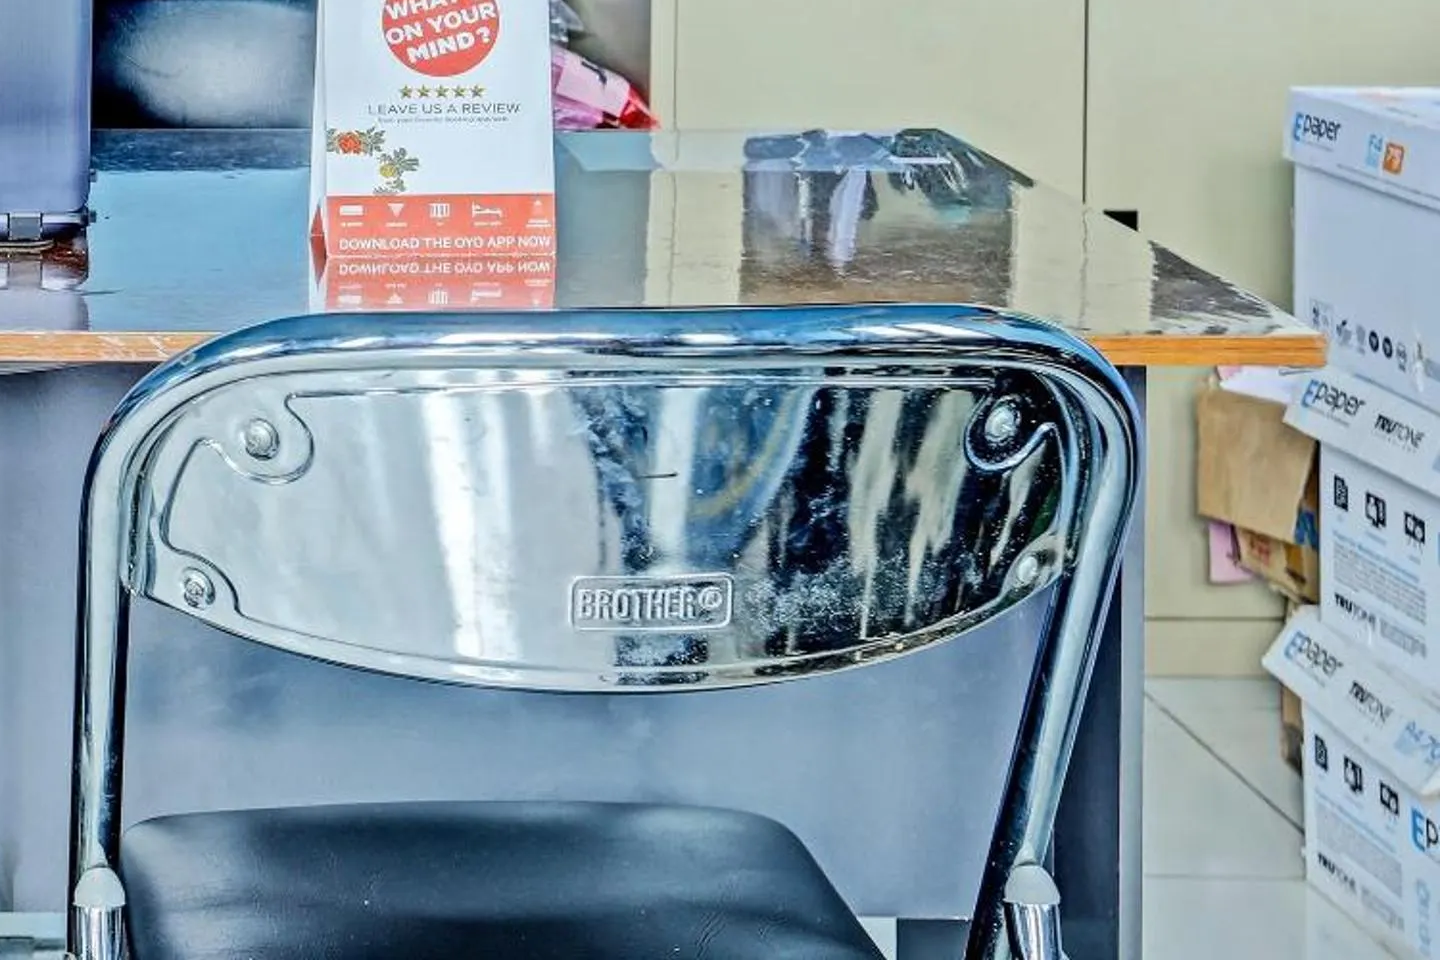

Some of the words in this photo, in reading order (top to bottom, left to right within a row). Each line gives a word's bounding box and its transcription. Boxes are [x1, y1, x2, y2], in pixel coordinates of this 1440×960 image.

[385, 22, 424, 45] ON
[426, 2, 496, 33] YOUR
[368, 103, 418, 115] LEAVE
[422, 103, 442, 114] US
[446, 103, 458, 114] A
[462, 103, 521, 115] REVIEW
[339, 237, 420, 250] DOWNLOAD
[424, 237, 451, 249] THE
[454, 236, 483, 249] OYO
[487, 236, 515, 248] APP
[517, 235, 552, 248] NOW
